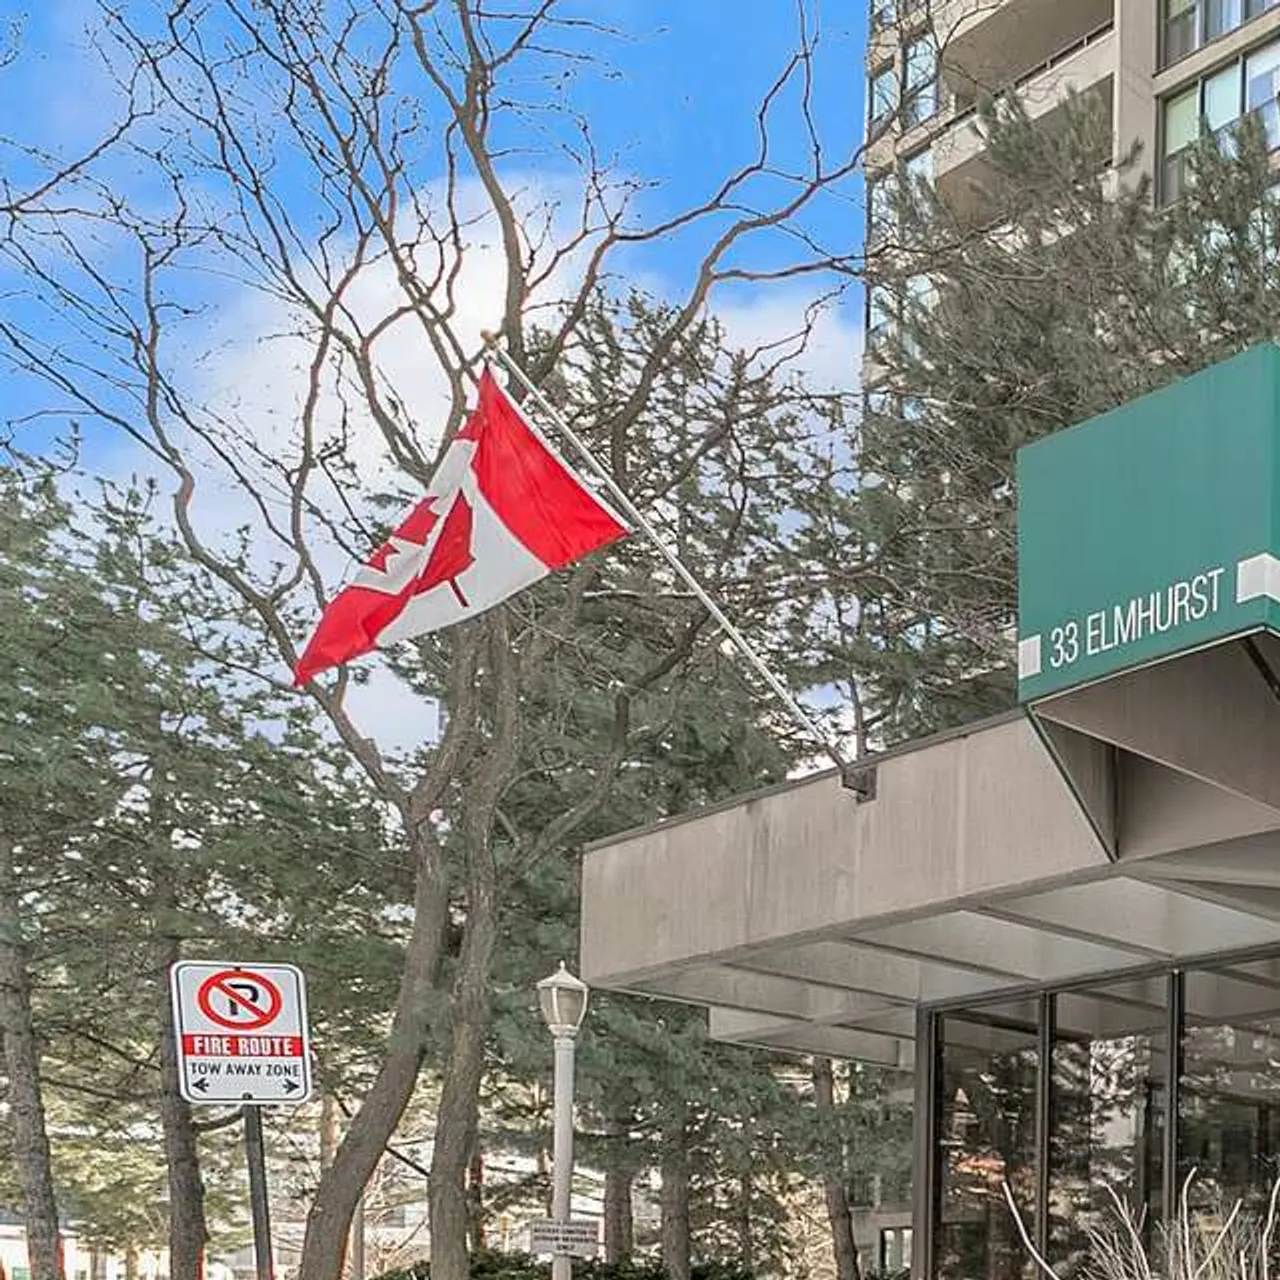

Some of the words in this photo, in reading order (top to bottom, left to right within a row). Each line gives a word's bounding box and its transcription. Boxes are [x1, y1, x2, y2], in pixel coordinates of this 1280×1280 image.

[1049, 621, 1079, 668] 33
[1086, 567, 1225, 656] ELMHURST
[193, 1036, 232, 1055] FIRE
[238, 1037, 294, 1056] ROUTE
[190, 1062, 221, 1075] TOW
[226, 1062, 262, 1076] AWAY
[266, 1064, 300, 1077] ZONE
